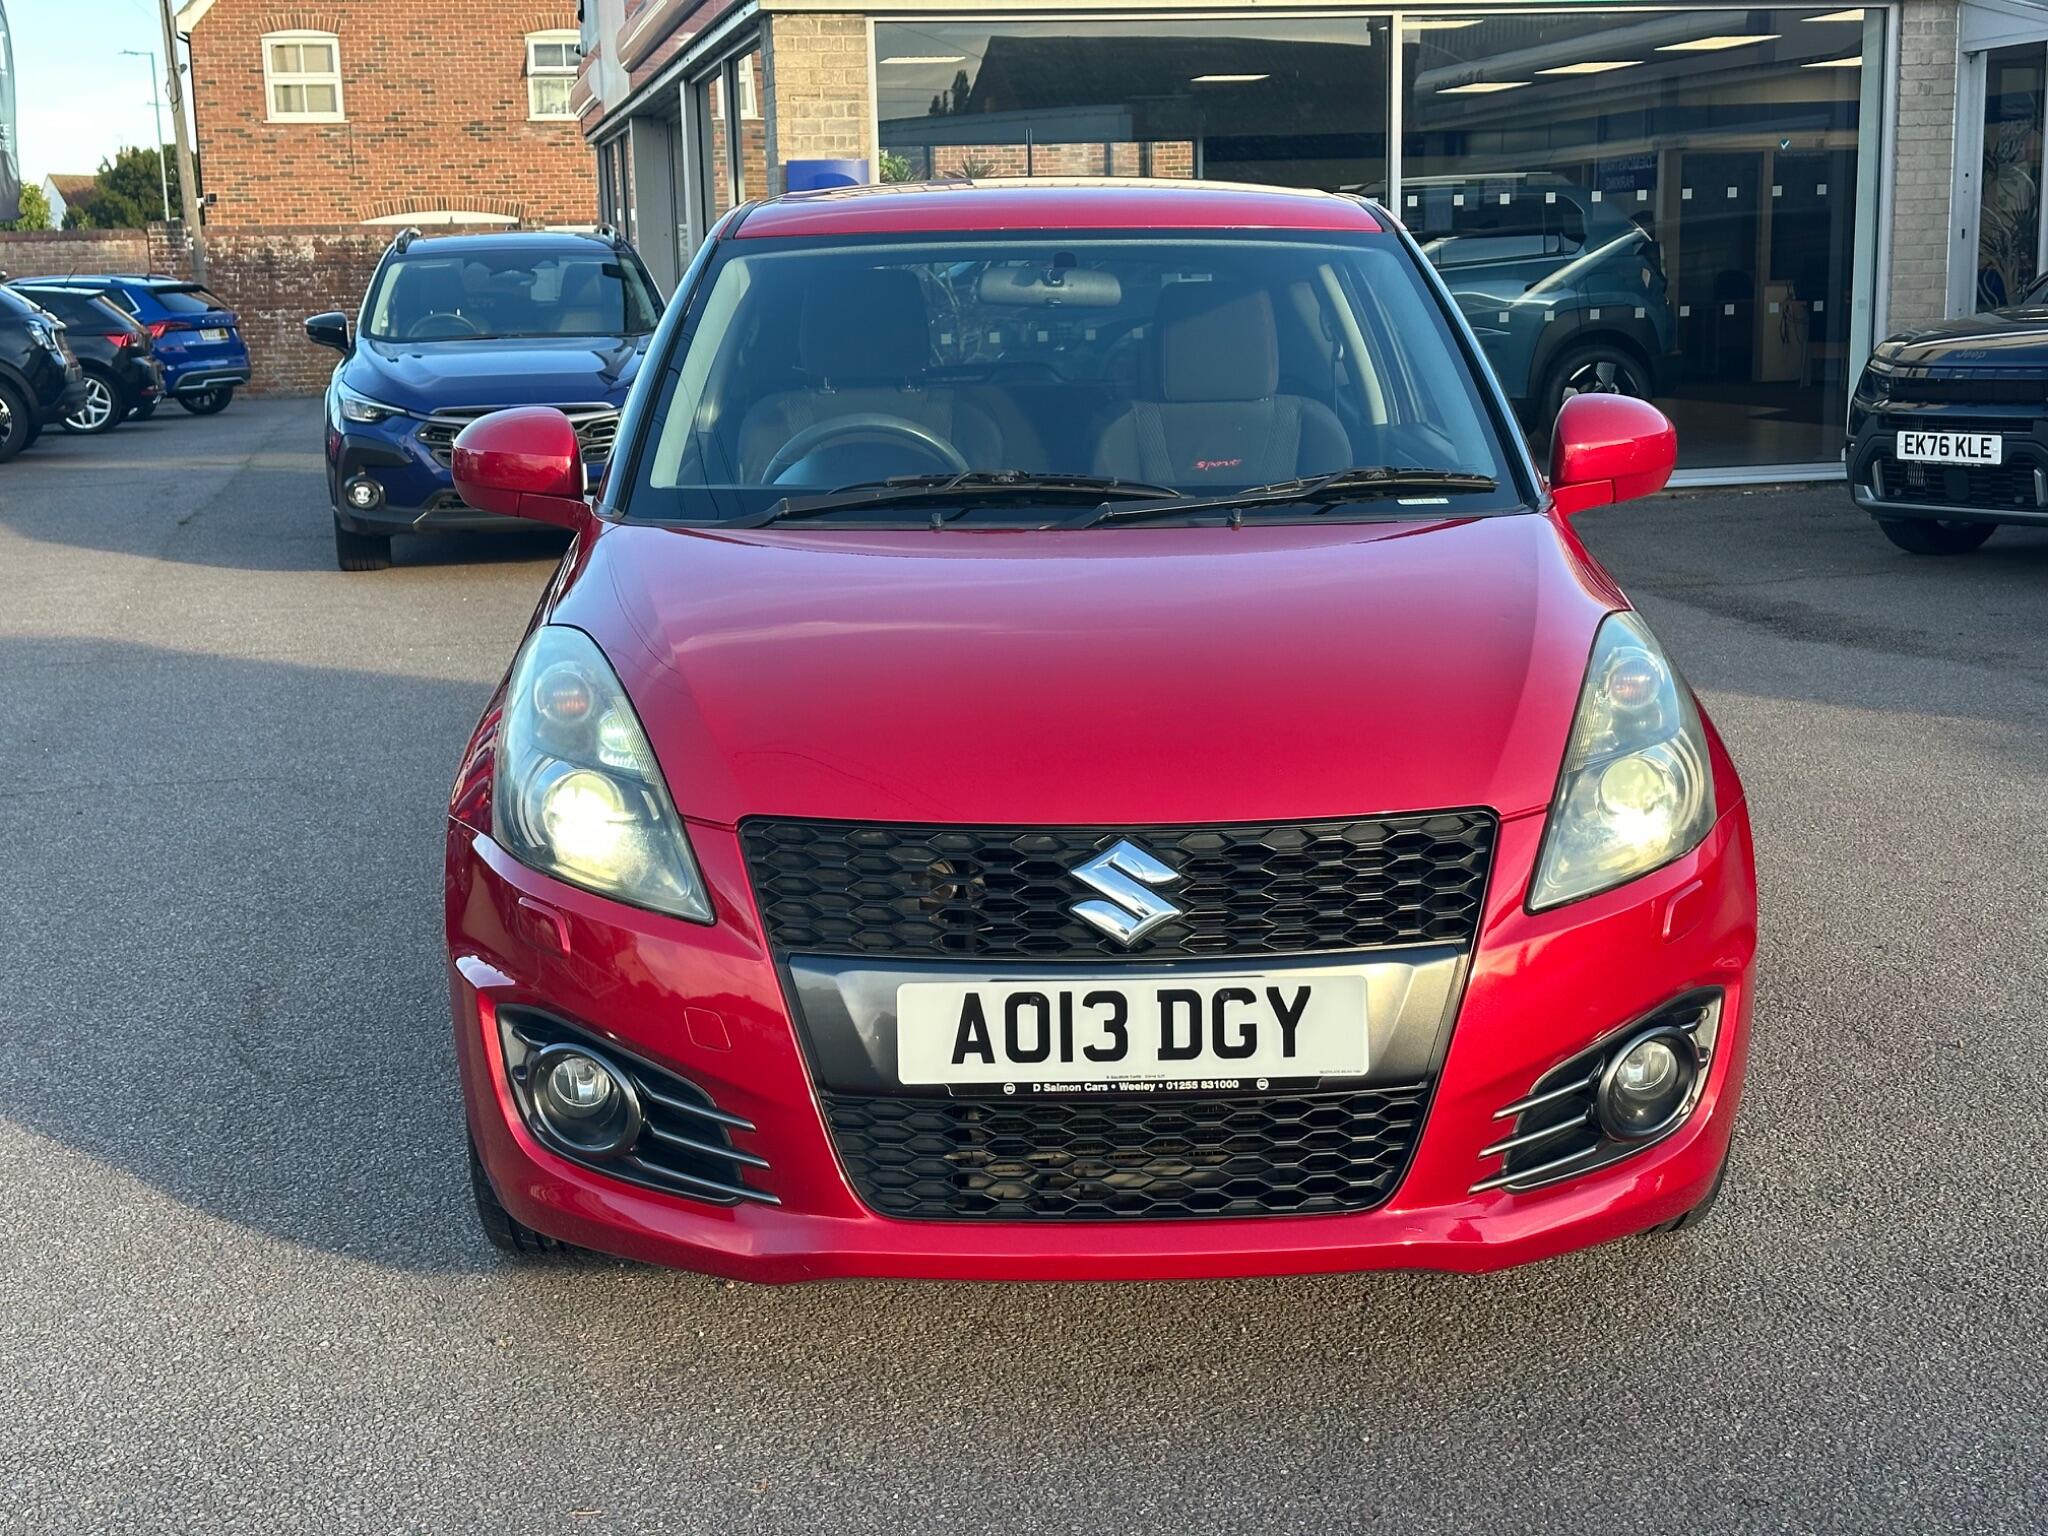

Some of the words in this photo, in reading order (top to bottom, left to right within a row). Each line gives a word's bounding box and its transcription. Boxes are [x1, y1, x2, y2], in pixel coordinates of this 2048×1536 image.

[1956, 349, 1987, 360] Jeep
[1904, 434, 1950, 457] EK76
[1955, 436, 1992, 459] KLE
[950, 990, 1128, 1064] AO13
[1156, 985, 1311, 1061] DGY
[1032, 1083, 1041, 1092] D
[1043, 1082, 1082, 1092] Salmon
[1084, 1082, 1109, 1092] Cars
[1118, 1081, 1156, 1092] Weeley
[1165, 1080, 1199, 1090] 01255
[1200, 1079, 1240, 1090] 831000
